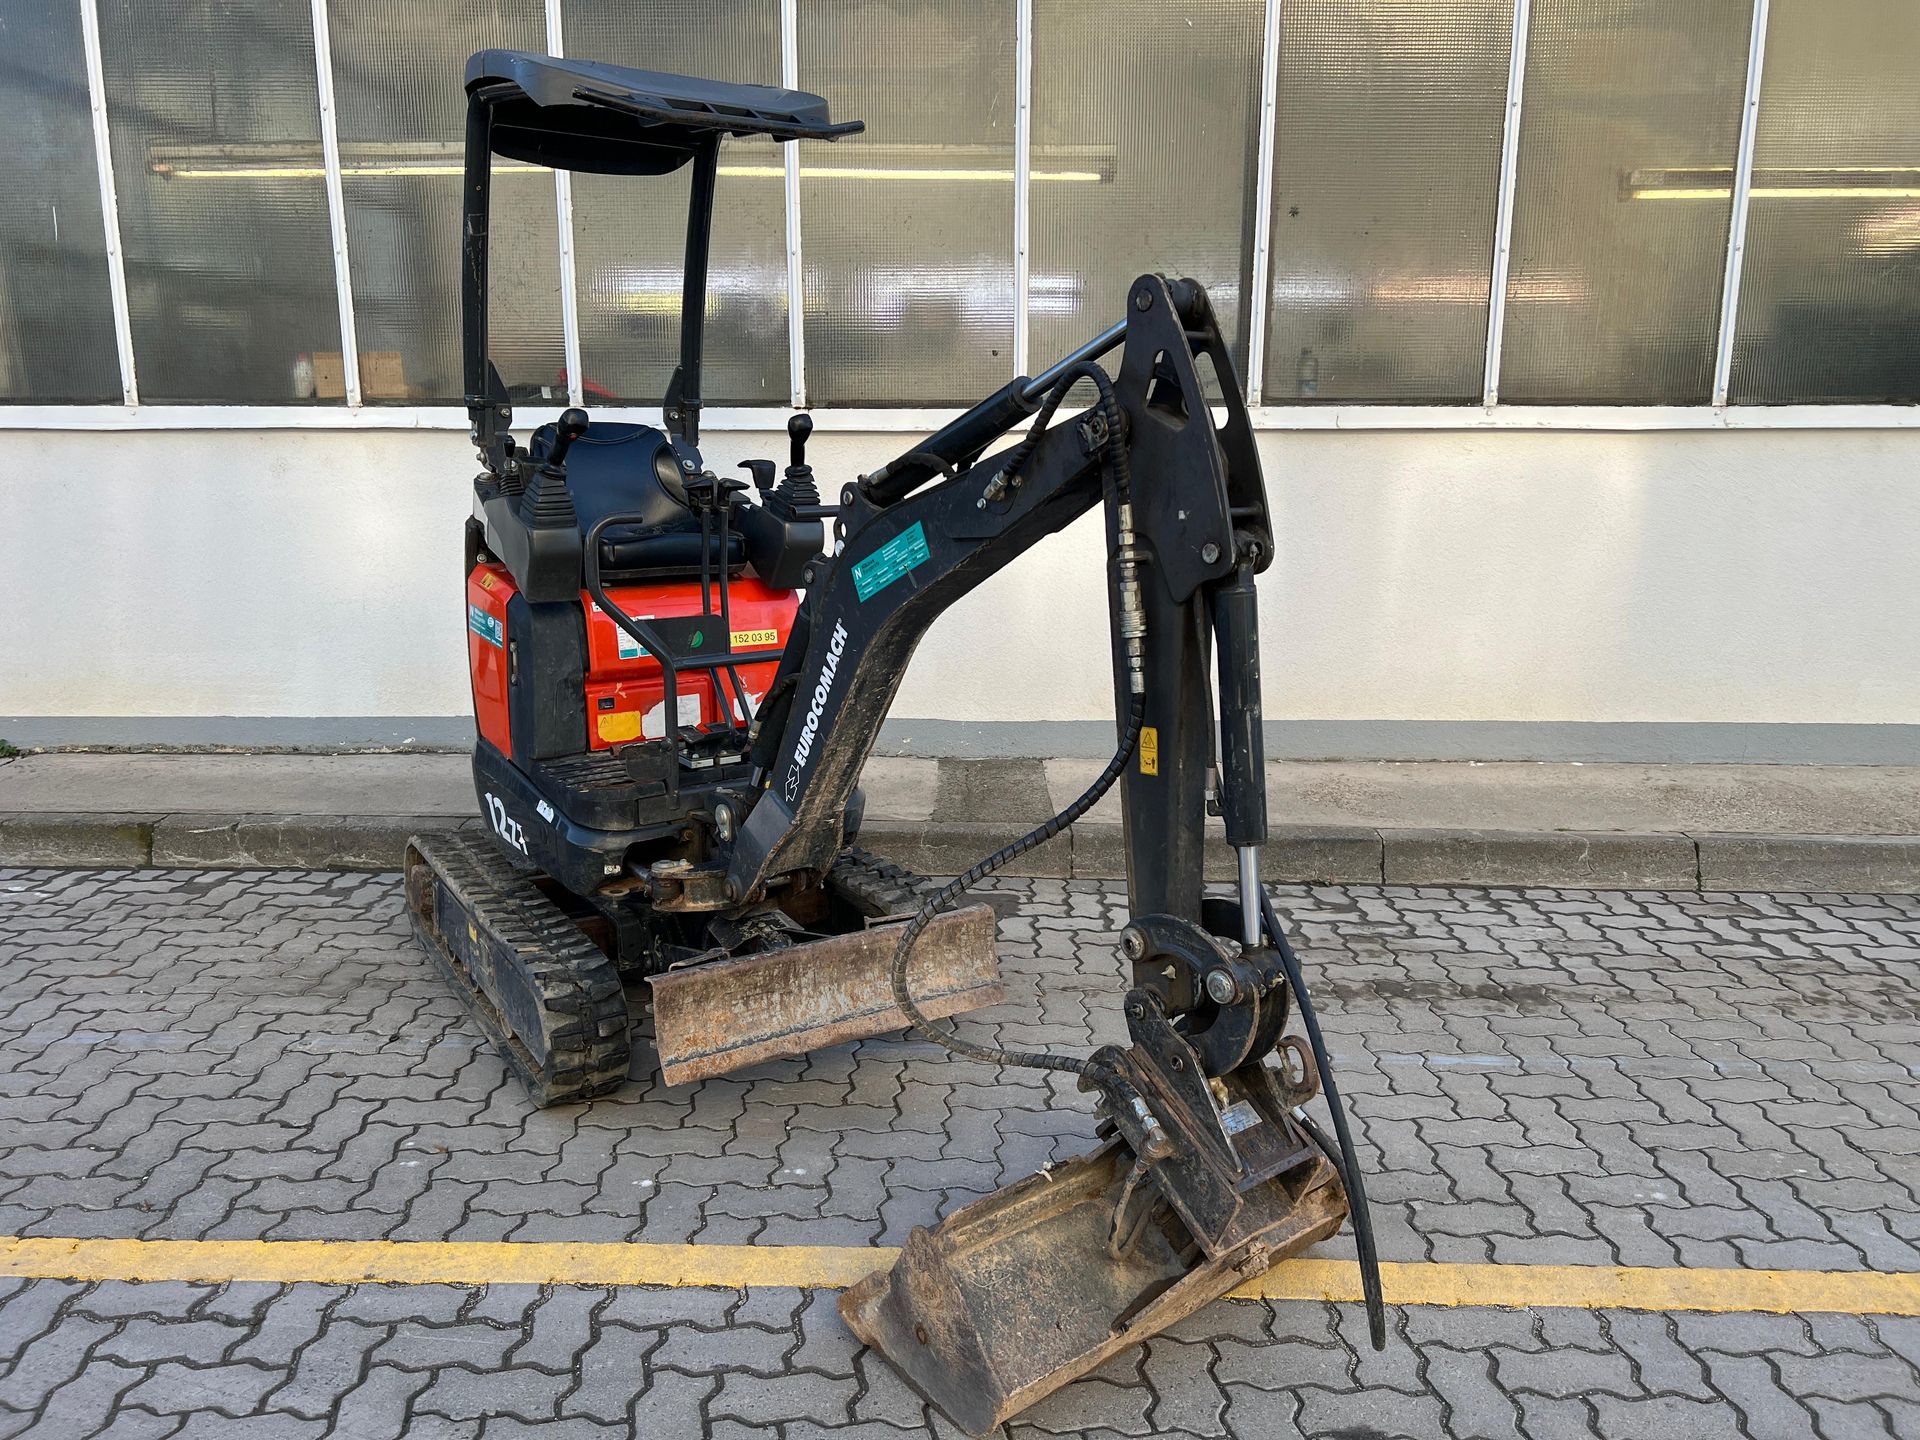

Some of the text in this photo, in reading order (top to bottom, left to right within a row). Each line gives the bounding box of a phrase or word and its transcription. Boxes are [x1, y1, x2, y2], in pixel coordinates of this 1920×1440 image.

[734, 632, 776, 643] 152 03 95
[793, 620, 848, 768] EUROCOMACH
